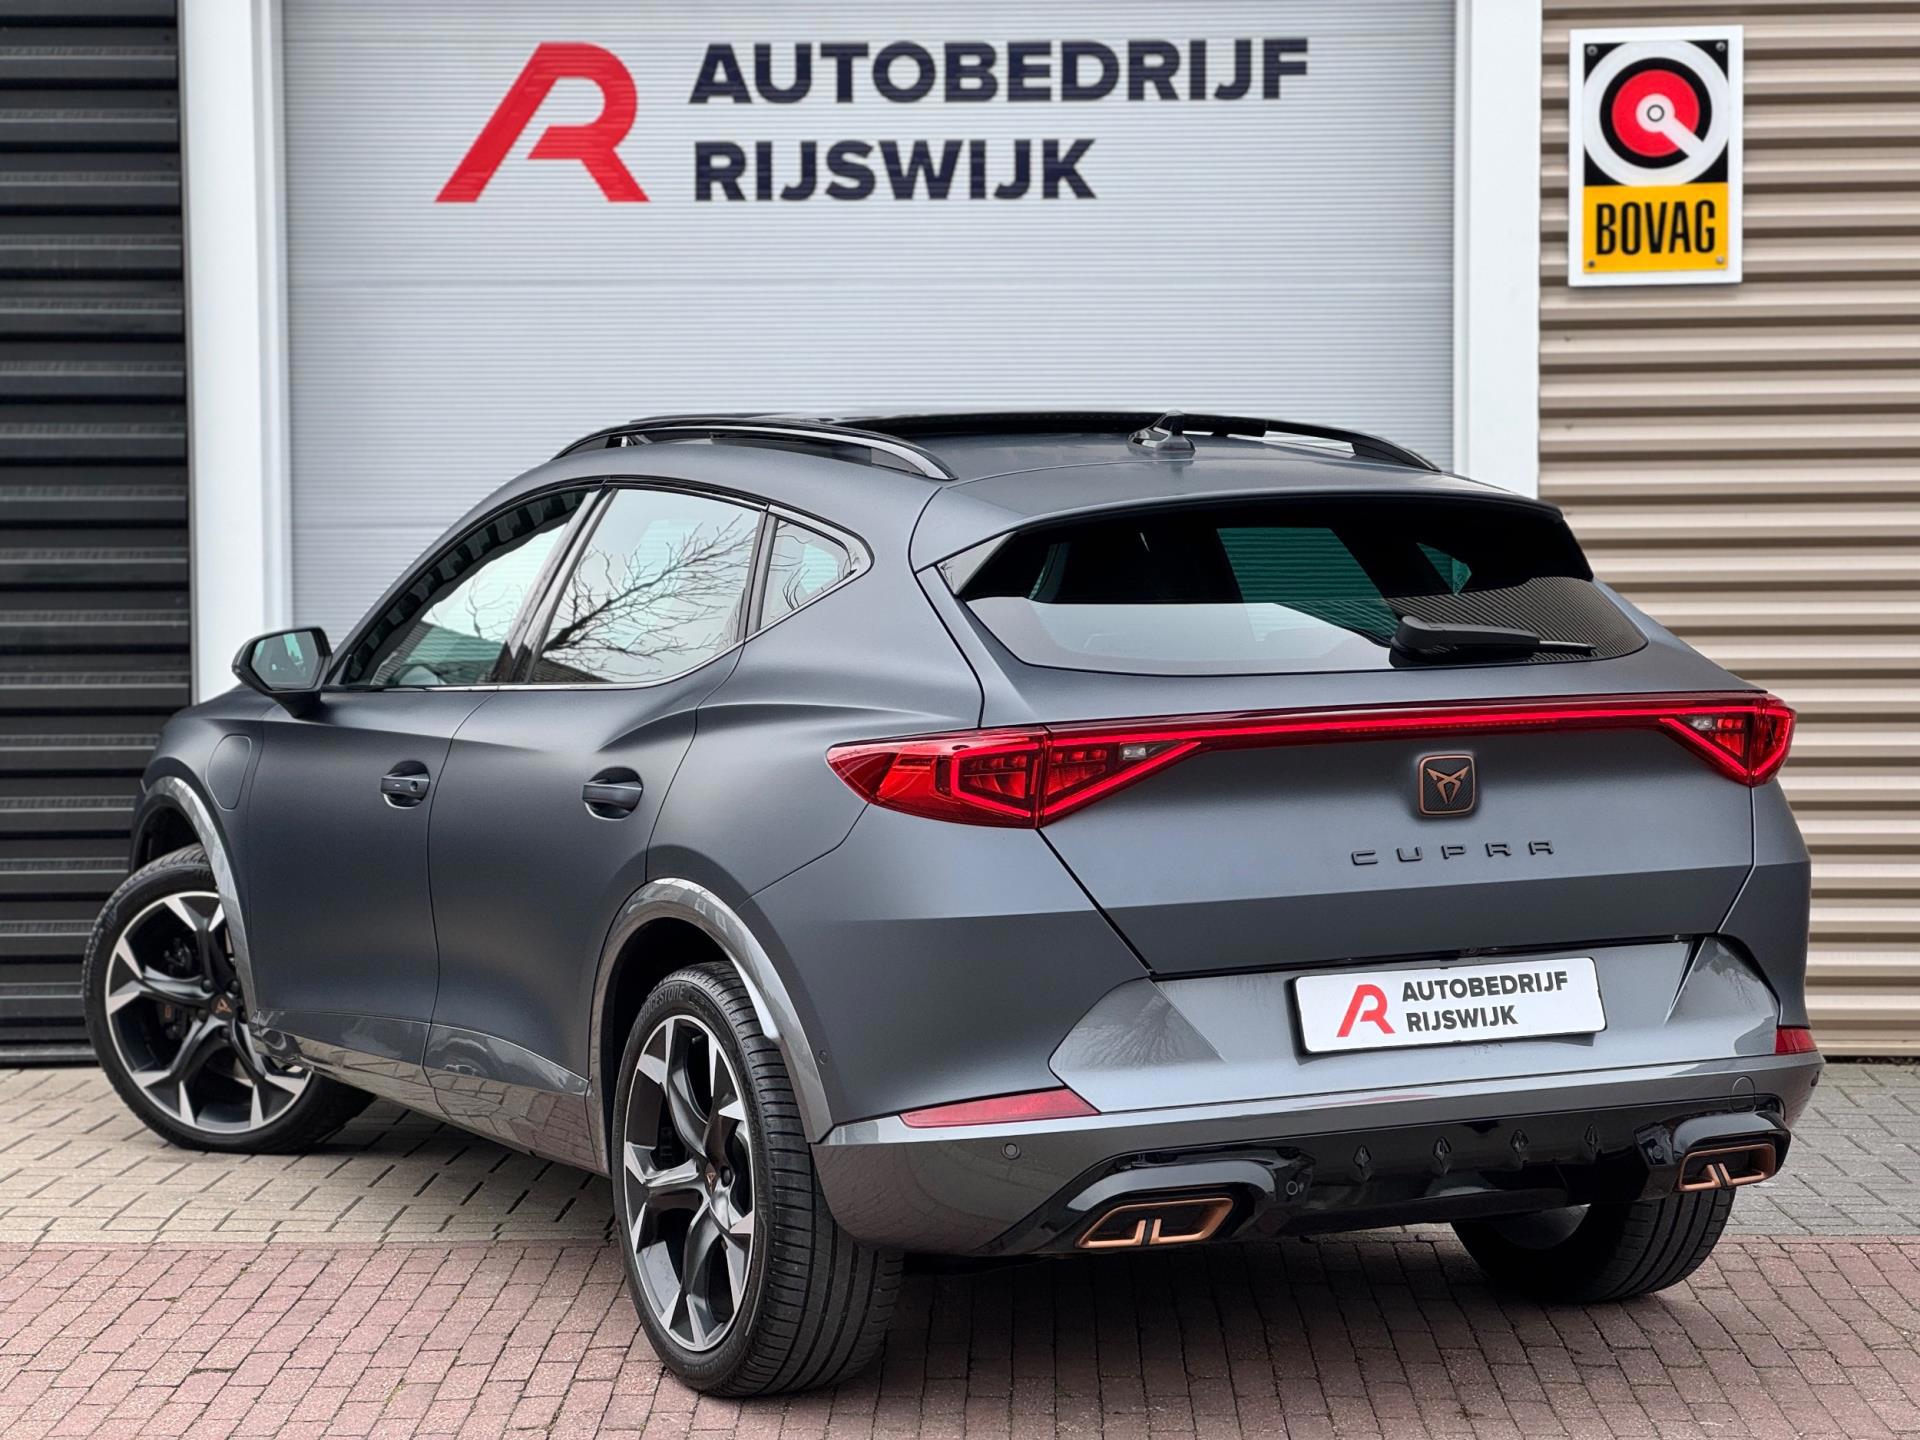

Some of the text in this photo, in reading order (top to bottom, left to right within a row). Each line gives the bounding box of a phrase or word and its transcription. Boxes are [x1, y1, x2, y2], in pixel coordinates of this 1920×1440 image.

[689, 37, 1310, 104] AUTOBEDRIJF
[694, 138, 1096, 201] RIJSWIJK
[1596, 200, 1715, 255] BOVAG
[1351, 840, 1555, 866] CUPRA
[1402, 971, 1568, 1002] AUTOBEDRIJF
[1405, 1005, 1518, 1032] RIJSWIJK
